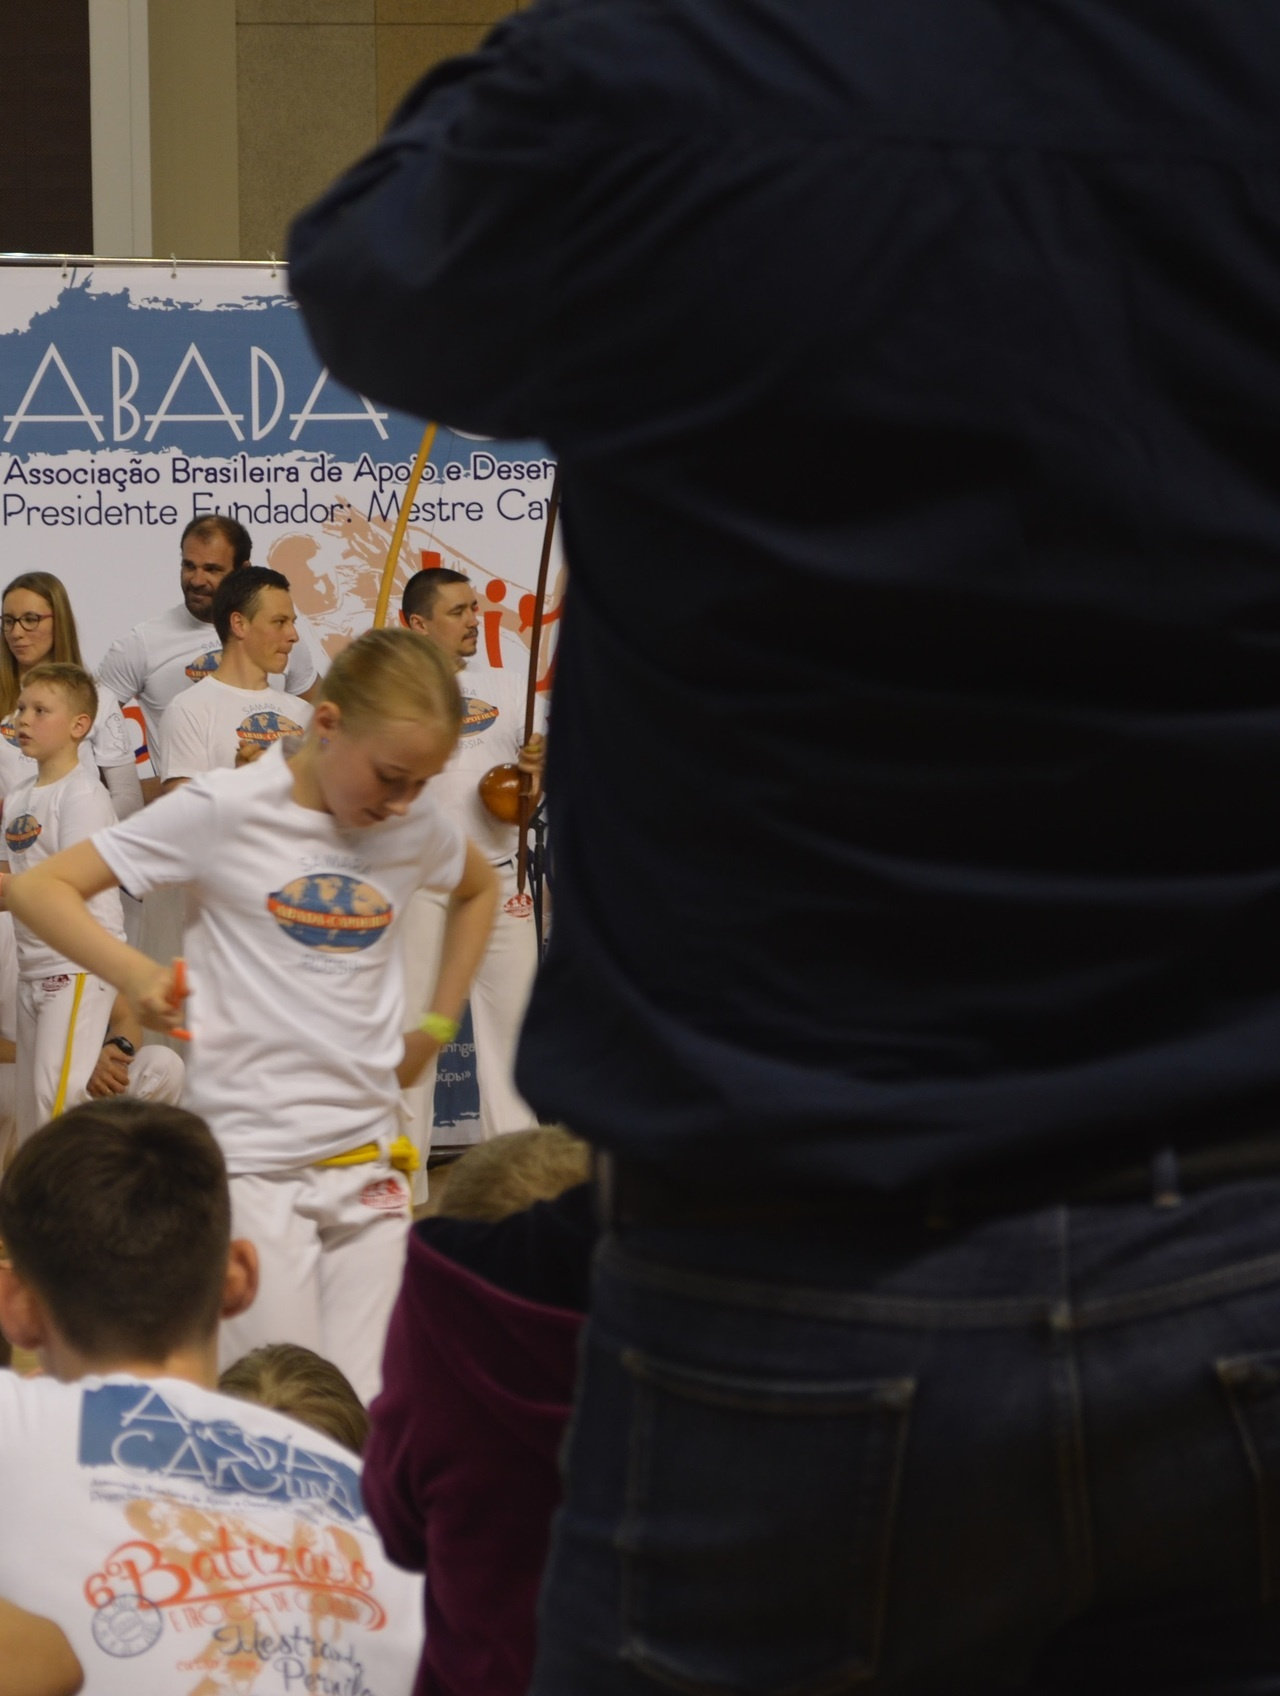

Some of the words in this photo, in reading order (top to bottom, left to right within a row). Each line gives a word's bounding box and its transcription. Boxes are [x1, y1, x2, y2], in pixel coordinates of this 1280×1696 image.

[3, 457, 160, 492] Associação
[172, 454, 299, 483] Brasileira
[310, 454, 342, 483] de
[446, 466, 462, 481] e
[3, 490, 178, 526] Presidente
[367, 490, 484, 523] Mestre
